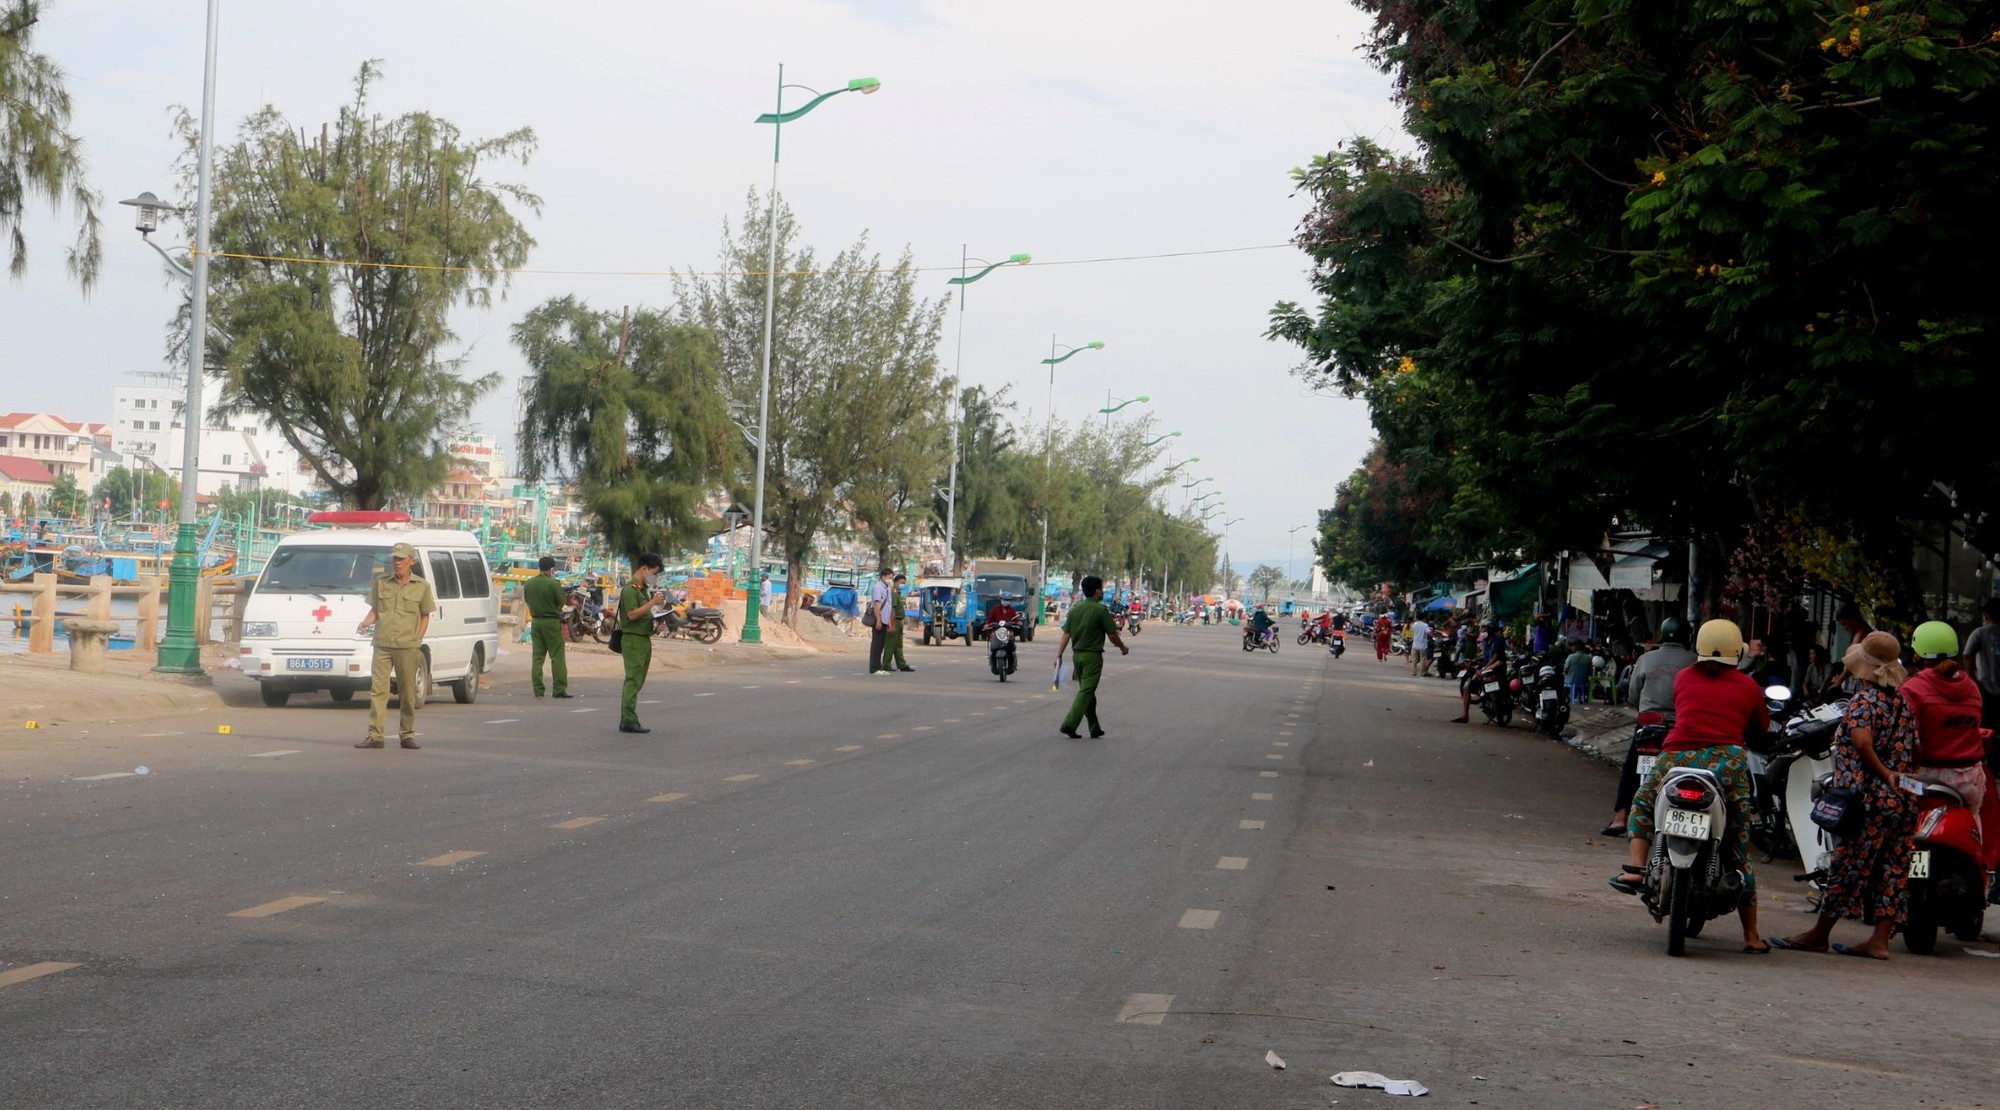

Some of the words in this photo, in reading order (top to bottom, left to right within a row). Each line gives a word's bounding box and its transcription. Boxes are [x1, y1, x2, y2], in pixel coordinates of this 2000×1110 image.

[289, 659, 331, 669] 86A-0515
[1671, 810, 1704, 826] 86-C1
[1664, 821, 1707, 838] 204.97
